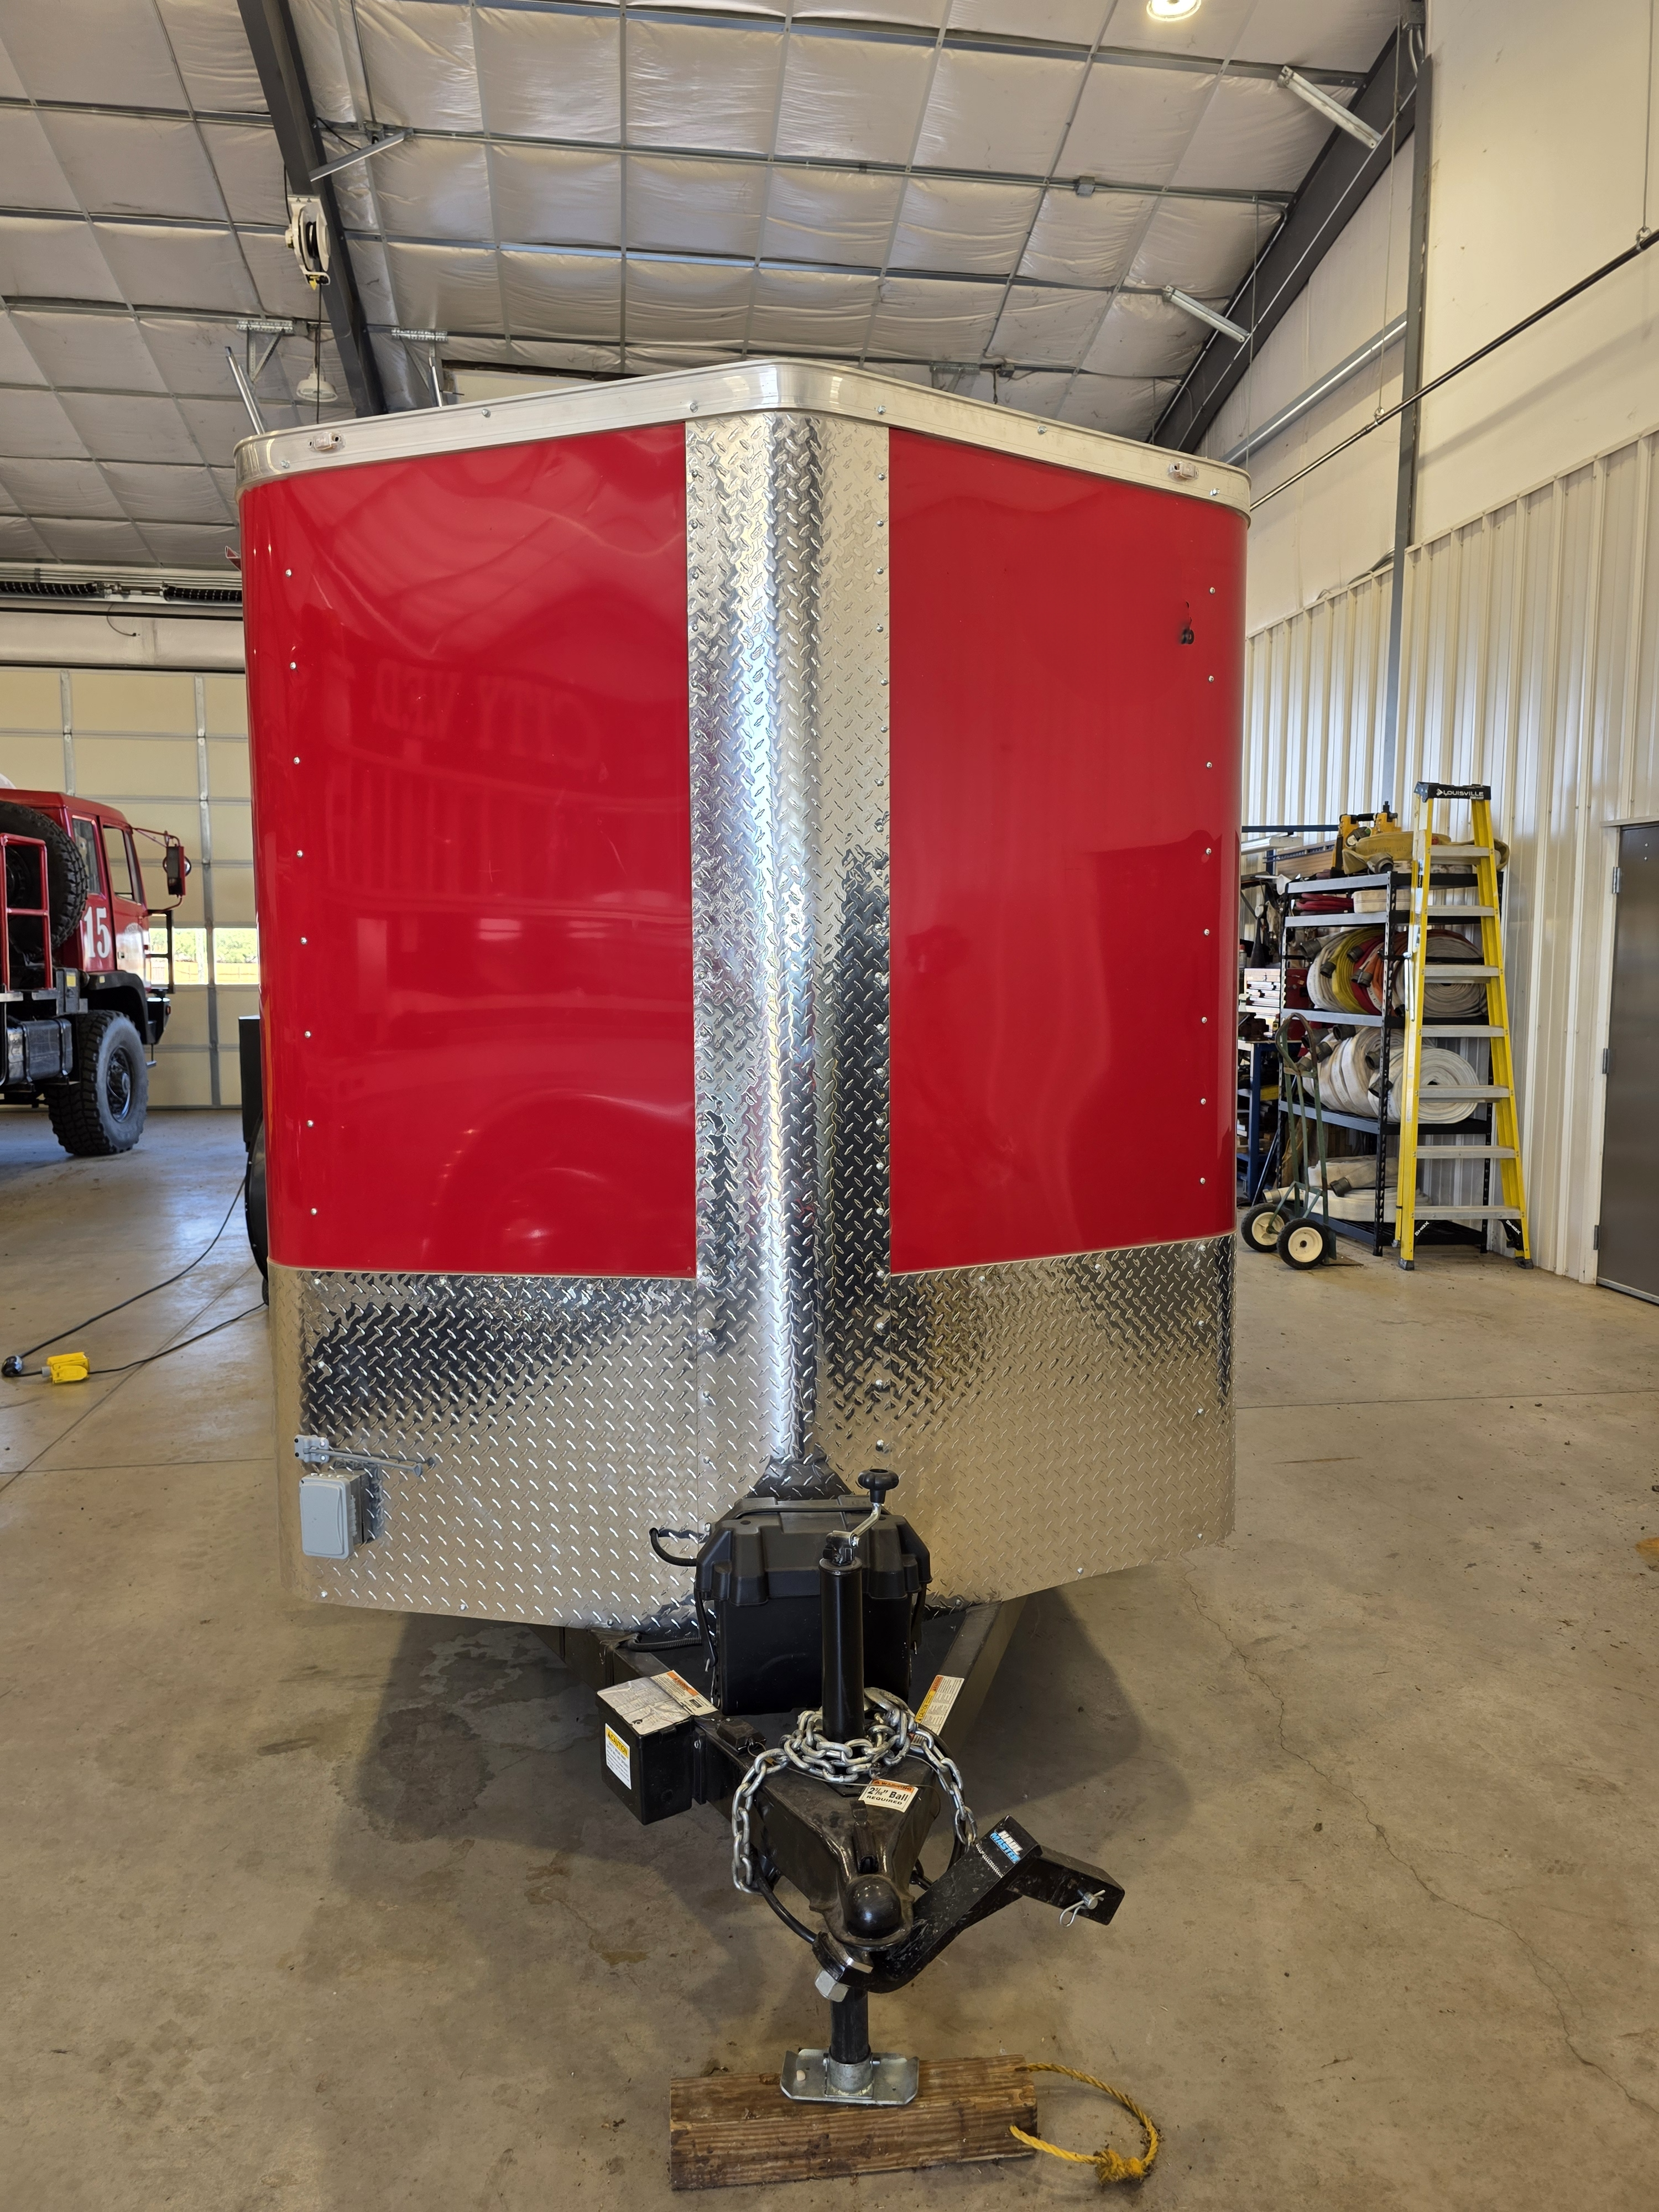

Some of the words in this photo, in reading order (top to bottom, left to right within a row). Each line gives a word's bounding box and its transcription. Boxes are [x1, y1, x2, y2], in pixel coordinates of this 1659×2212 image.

[84, 906, 111, 958] 15
[611, 1734, 628, 1756] CAUTION
[866, 1795, 902, 1805] REQUIRED
[889, 1791, 909, 1801] Ball
[990, 1832, 1020, 1862] MASTER
[998, 1830, 1022, 1855] HAUL
